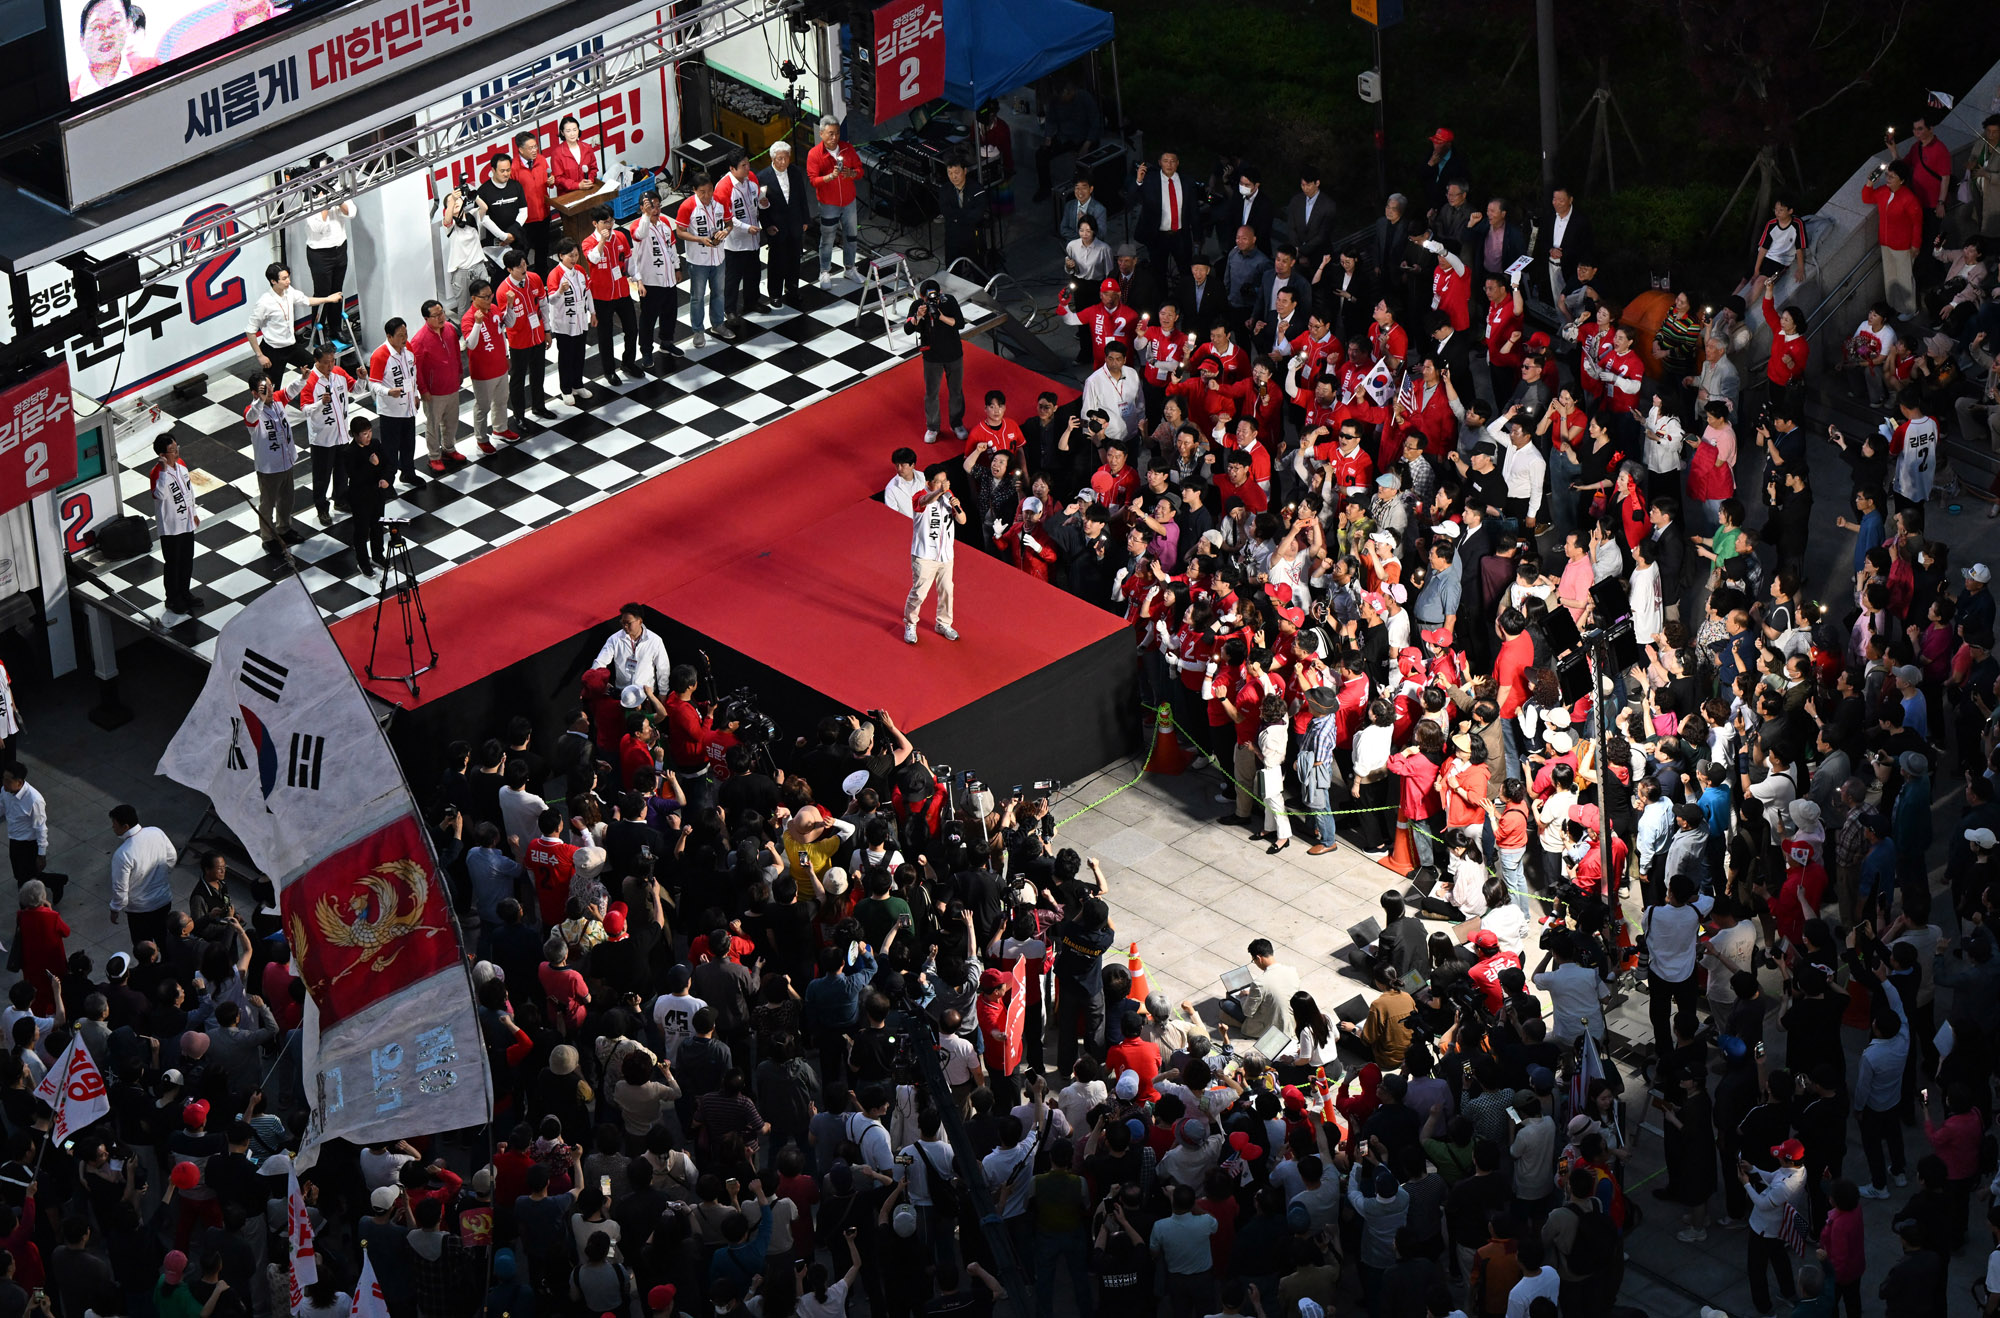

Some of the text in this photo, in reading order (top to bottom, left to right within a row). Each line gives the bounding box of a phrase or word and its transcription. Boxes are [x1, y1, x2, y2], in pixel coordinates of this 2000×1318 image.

[877, 10, 943, 67] 김문수
[184, 0, 475, 144] 새롭게 대한민국!
[899, 57, 920, 101] 2
[733, 198, 746, 220] 김문
[695, 215, 709, 248] 김문
[181, 203, 247, 325] 2
[1095, 314, 1104, 345] 김문수
[1113, 316, 1127, 337] 2
[13, 387, 49, 416] 정정당당
[0, 393, 70, 455] 김문수
[263, 420, 281, 452] 김문수
[1909, 432, 1936, 449] 김문수
[24, 441, 50, 488] 2
[1917, 447, 1929, 473] 2
[169, 481, 188, 515] 김문수
[60, 492, 95, 554] 2
[1184, 640, 1195, 660] 2
[530, 849, 559, 866] 김문수
[664, 1009, 689, 1032] 45
